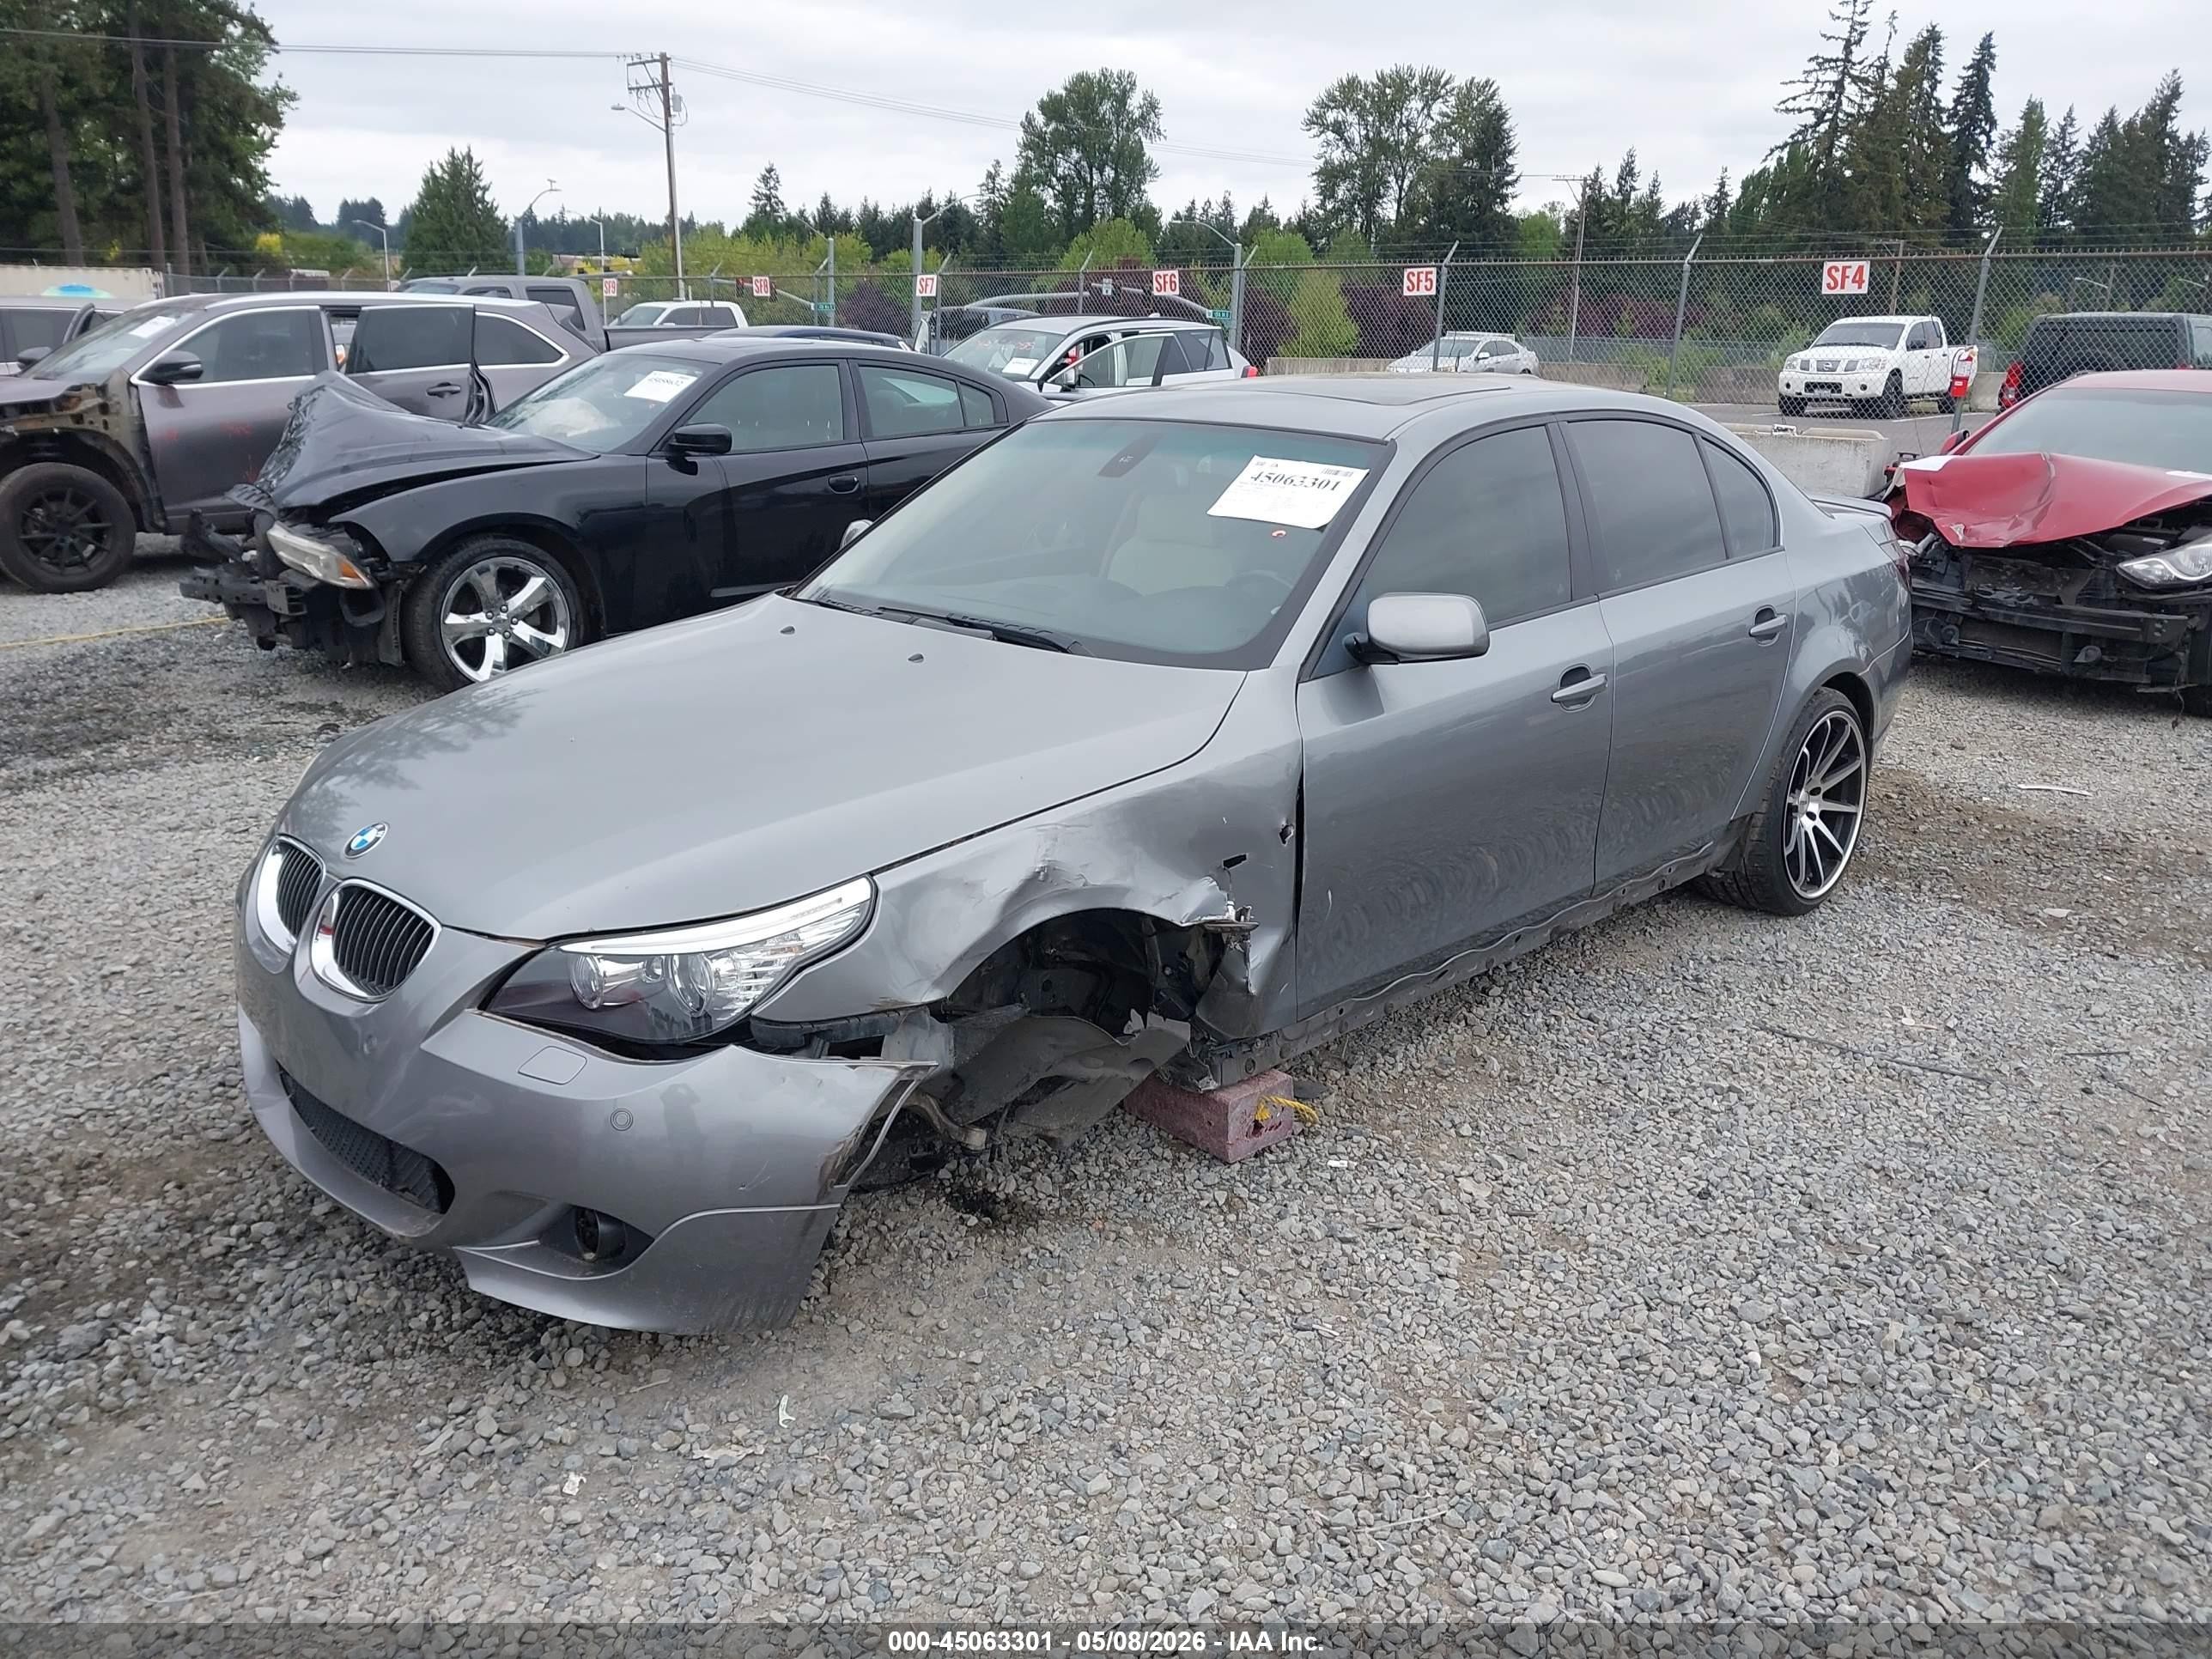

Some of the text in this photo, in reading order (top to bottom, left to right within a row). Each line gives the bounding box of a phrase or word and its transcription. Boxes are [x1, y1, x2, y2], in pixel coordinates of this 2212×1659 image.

[755, 278, 769, 294] SF8
[919, 277, 935, 295] SF7
[1155, 273, 1177, 293] SF6
[1406, 270, 1434, 292] SF5
[1826, 264, 1866, 290] SF4
[604, 280, 616, 295] SF9
[1250, 471, 1341, 491] 45063301
